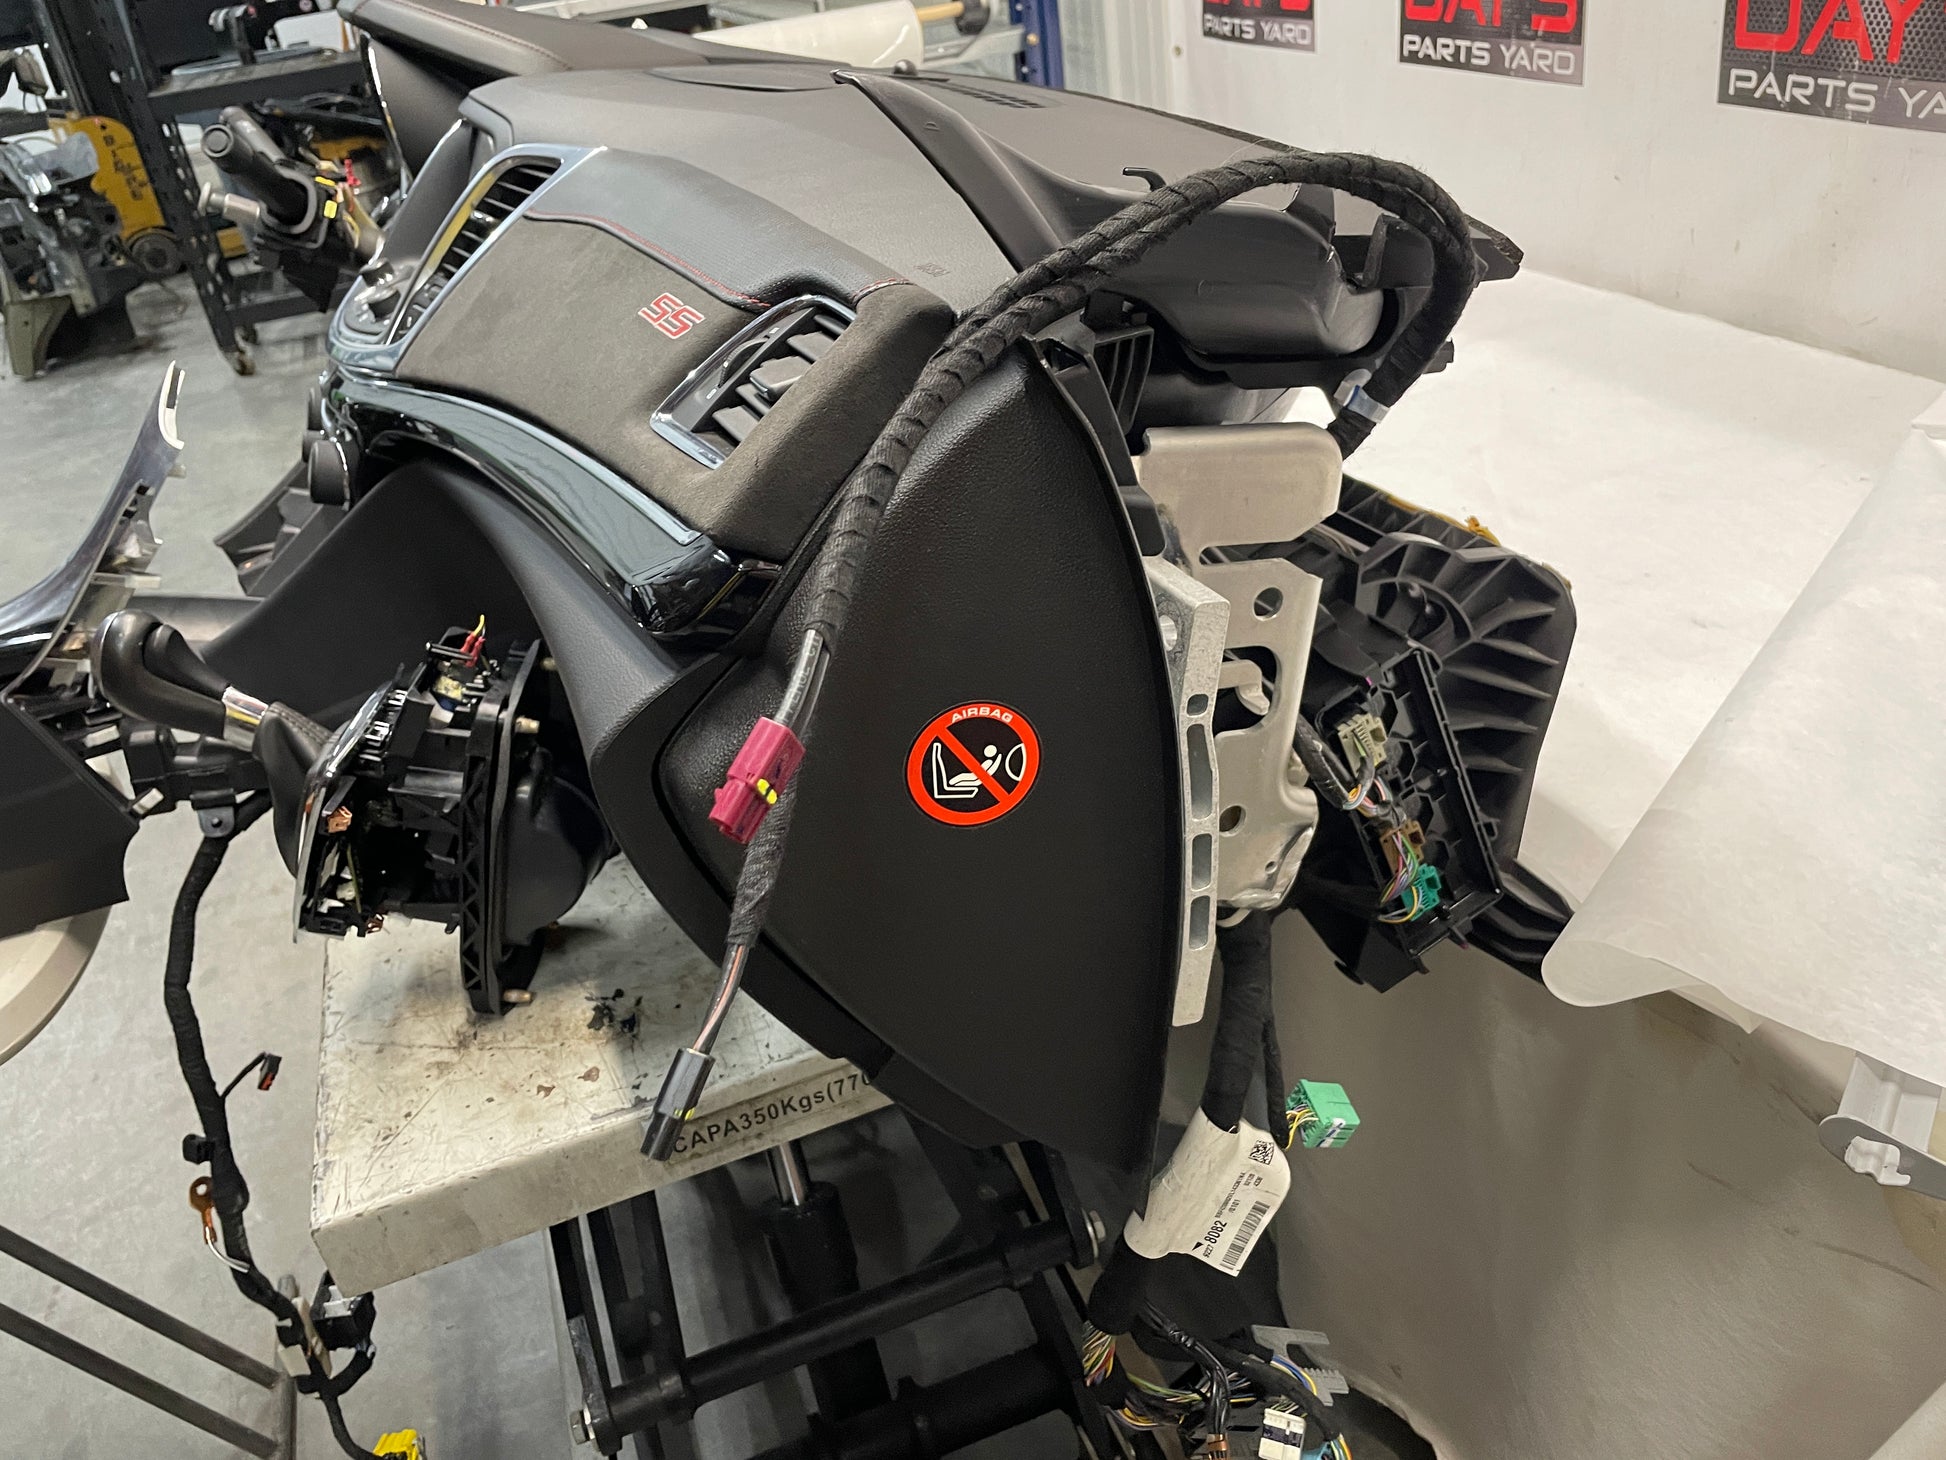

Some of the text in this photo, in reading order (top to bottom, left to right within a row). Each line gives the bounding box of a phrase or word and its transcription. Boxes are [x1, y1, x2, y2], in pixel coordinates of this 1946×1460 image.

[1203, 13, 1312, 46] PARTS YARD
[1402, 34, 1576, 76] PARTS YARD
[1728, 68, 1879, 113] PARTS
[637, 291, 706, 340] SS
[950, 706, 1014, 724] AIRBAG
[1203, 1219, 1228, 1245] 8082
